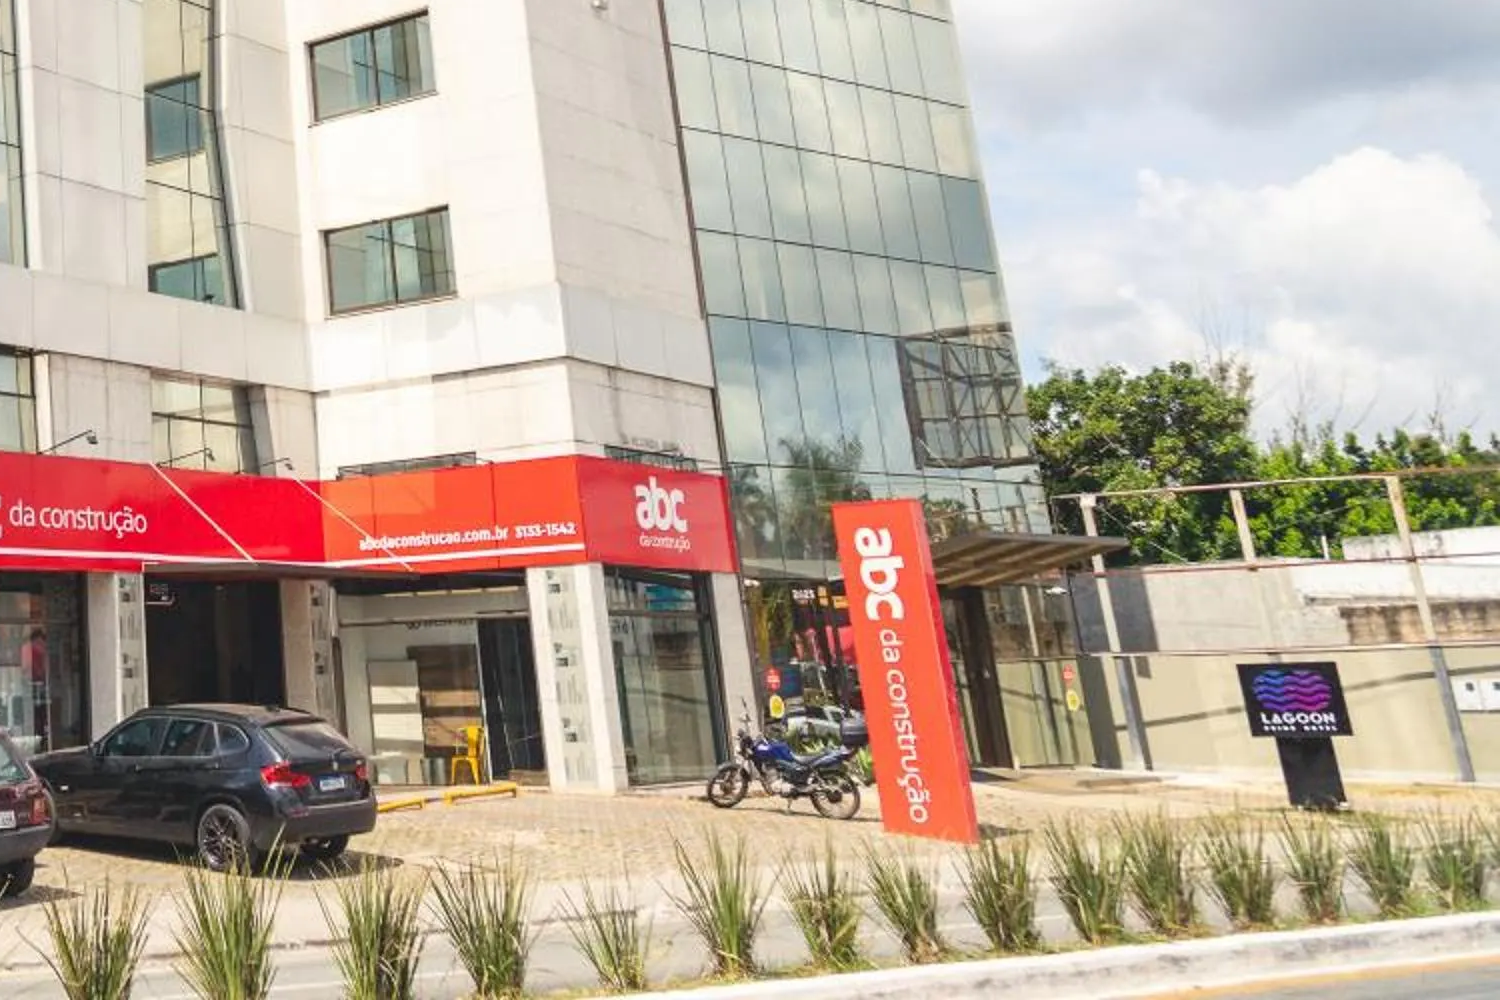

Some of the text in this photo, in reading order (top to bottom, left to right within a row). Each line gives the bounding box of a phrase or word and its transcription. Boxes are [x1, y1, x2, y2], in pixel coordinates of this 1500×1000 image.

[9, 500, 35, 527] da
[39, 505, 147, 538] construção
[634, 476, 688, 533] abc
[854, 527, 930, 823] abc da construção
[1260, 711, 1336, 725] LAGOON
